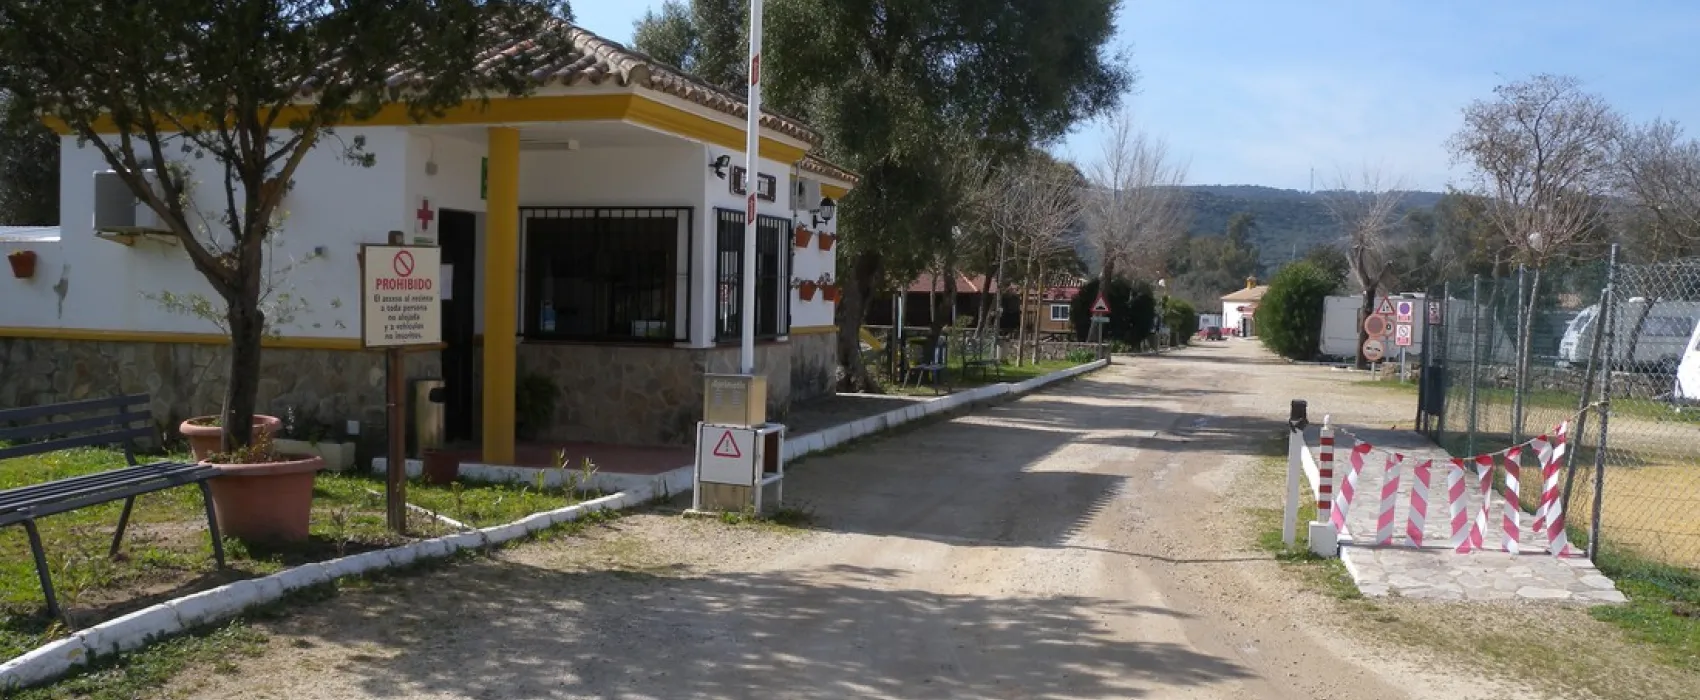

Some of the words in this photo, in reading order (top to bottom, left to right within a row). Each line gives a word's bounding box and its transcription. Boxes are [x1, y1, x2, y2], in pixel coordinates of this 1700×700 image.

[376, 278, 432, 290] PROHIBIDO
[374, 294, 380, 302] El
[405, 294, 410, 302] al
[411, 294, 433, 302] recinto
[386, 304, 401, 312] toda
[403, 305, 427, 313] persona
[384, 324, 388, 332] y
